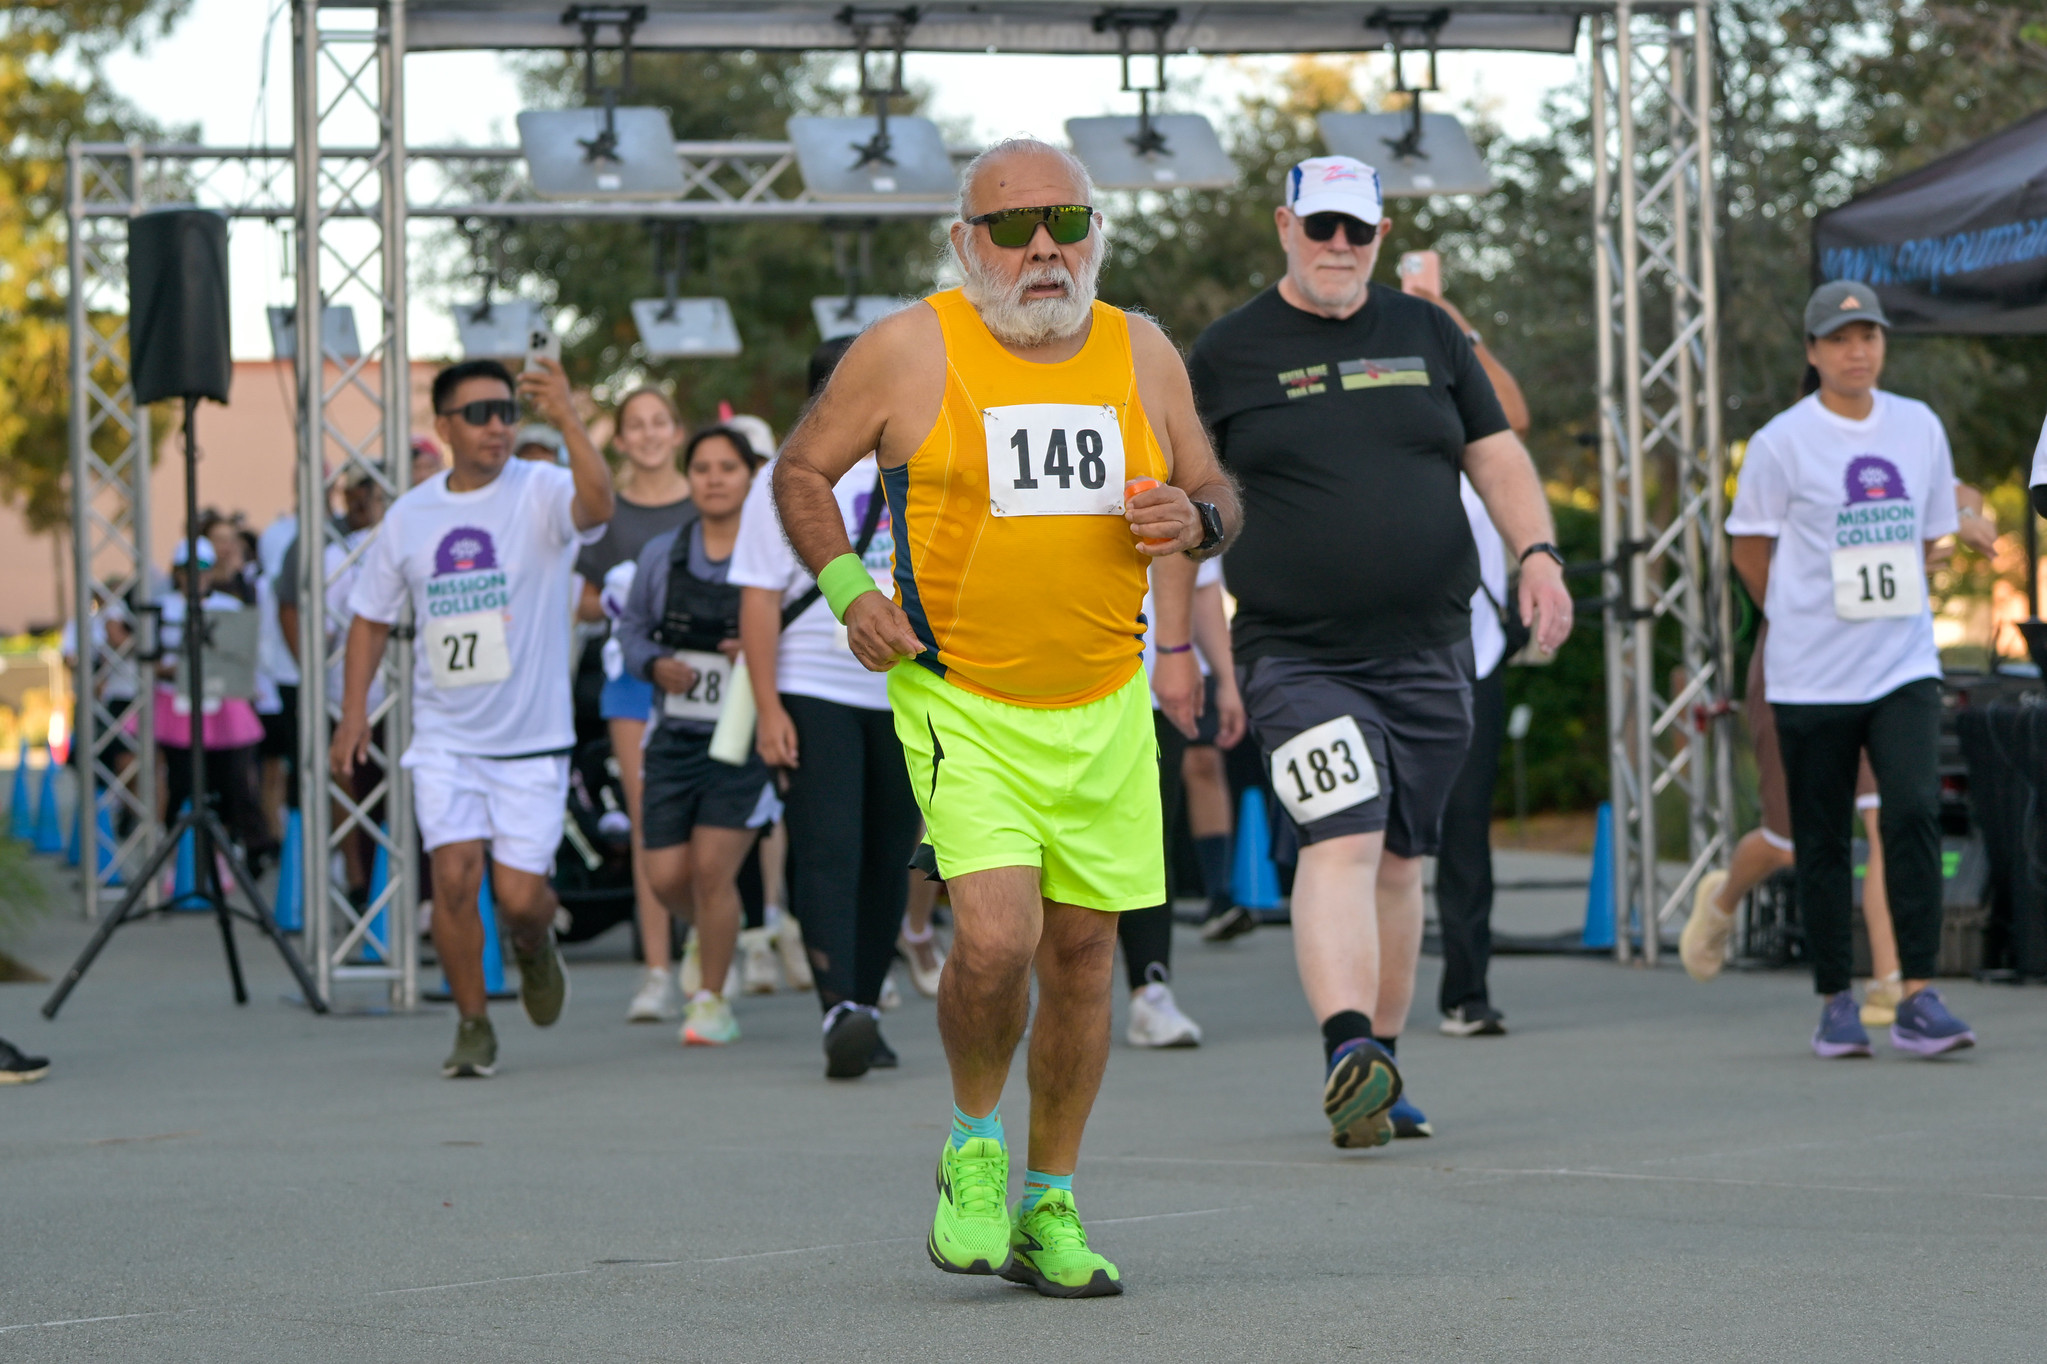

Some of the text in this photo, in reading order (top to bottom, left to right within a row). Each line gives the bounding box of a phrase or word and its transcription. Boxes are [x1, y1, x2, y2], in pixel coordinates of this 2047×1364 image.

[1011, 428, 1106, 490] 148
[1837, 505, 1914, 526] MISSION
[427, 572, 506, 597] MISSION
[1858, 563, 1895, 601] 16
[443, 633, 478, 671] 27
[686, 669, 721, 704] 28
[1287, 739, 1359, 802] 183
